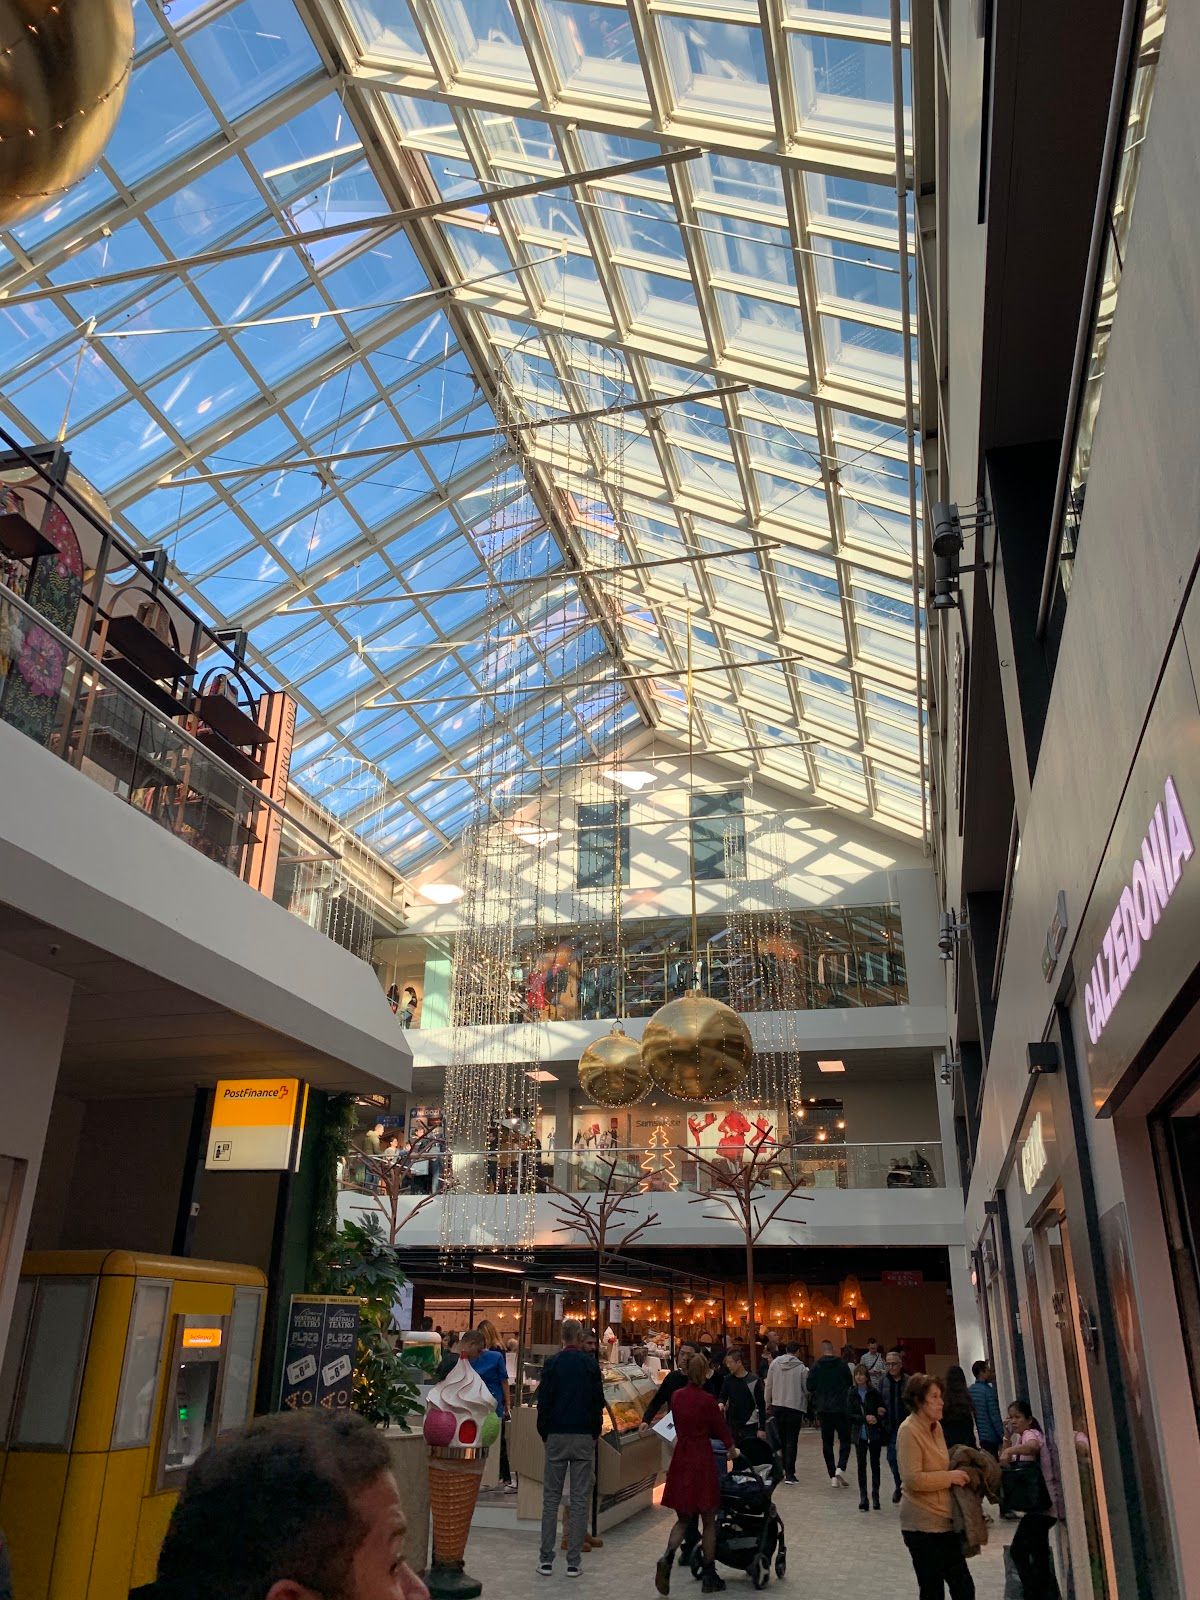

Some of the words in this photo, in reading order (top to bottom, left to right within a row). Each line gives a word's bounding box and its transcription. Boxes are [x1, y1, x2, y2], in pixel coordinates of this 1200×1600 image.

[285, 701, 295, 738] 1902
[1083, 774, 1195, 1045] CALZEDONIA
[223, 1088, 279, 1098] PostFinance
[635, 1119, 681, 1127] Samste
[294, 1320, 320, 1328] TEATRO
[328, 1321, 355, 1329] TEATRO
